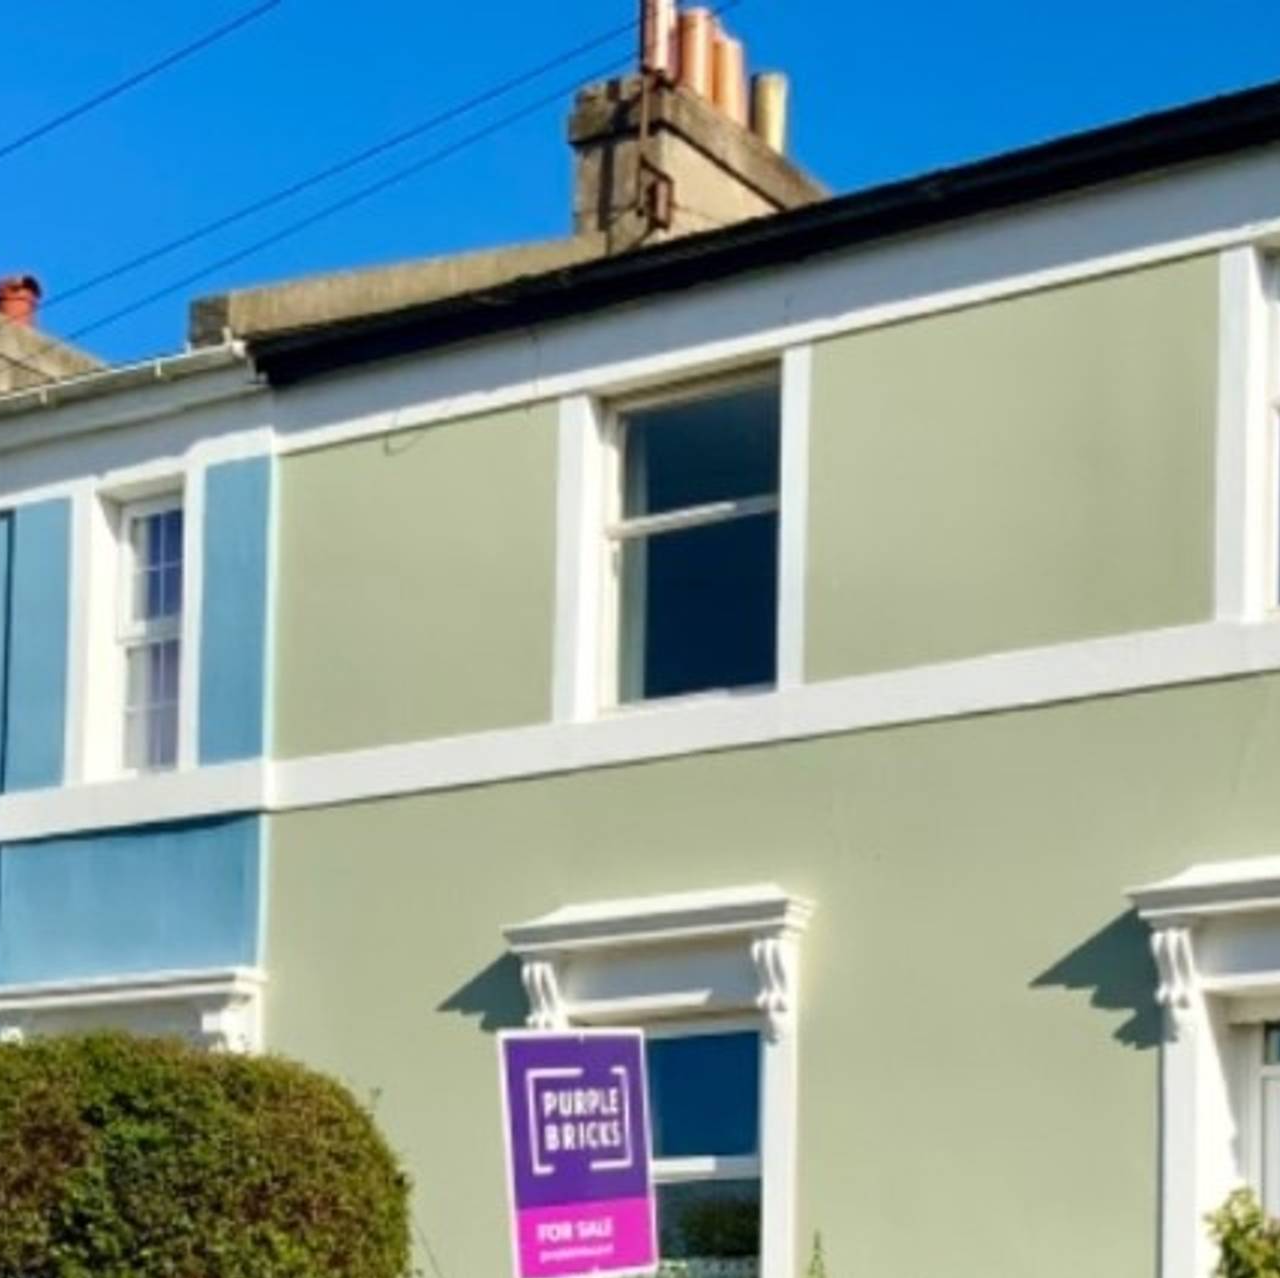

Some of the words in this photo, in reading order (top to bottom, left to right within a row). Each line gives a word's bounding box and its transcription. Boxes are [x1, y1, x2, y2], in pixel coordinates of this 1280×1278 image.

[543, 1087, 619, 1117] PURPLE
[544, 1120, 621, 1151] BRICKS
[536, 1222, 572, 1242] FOR
[577, 1217, 613, 1238] SALE
